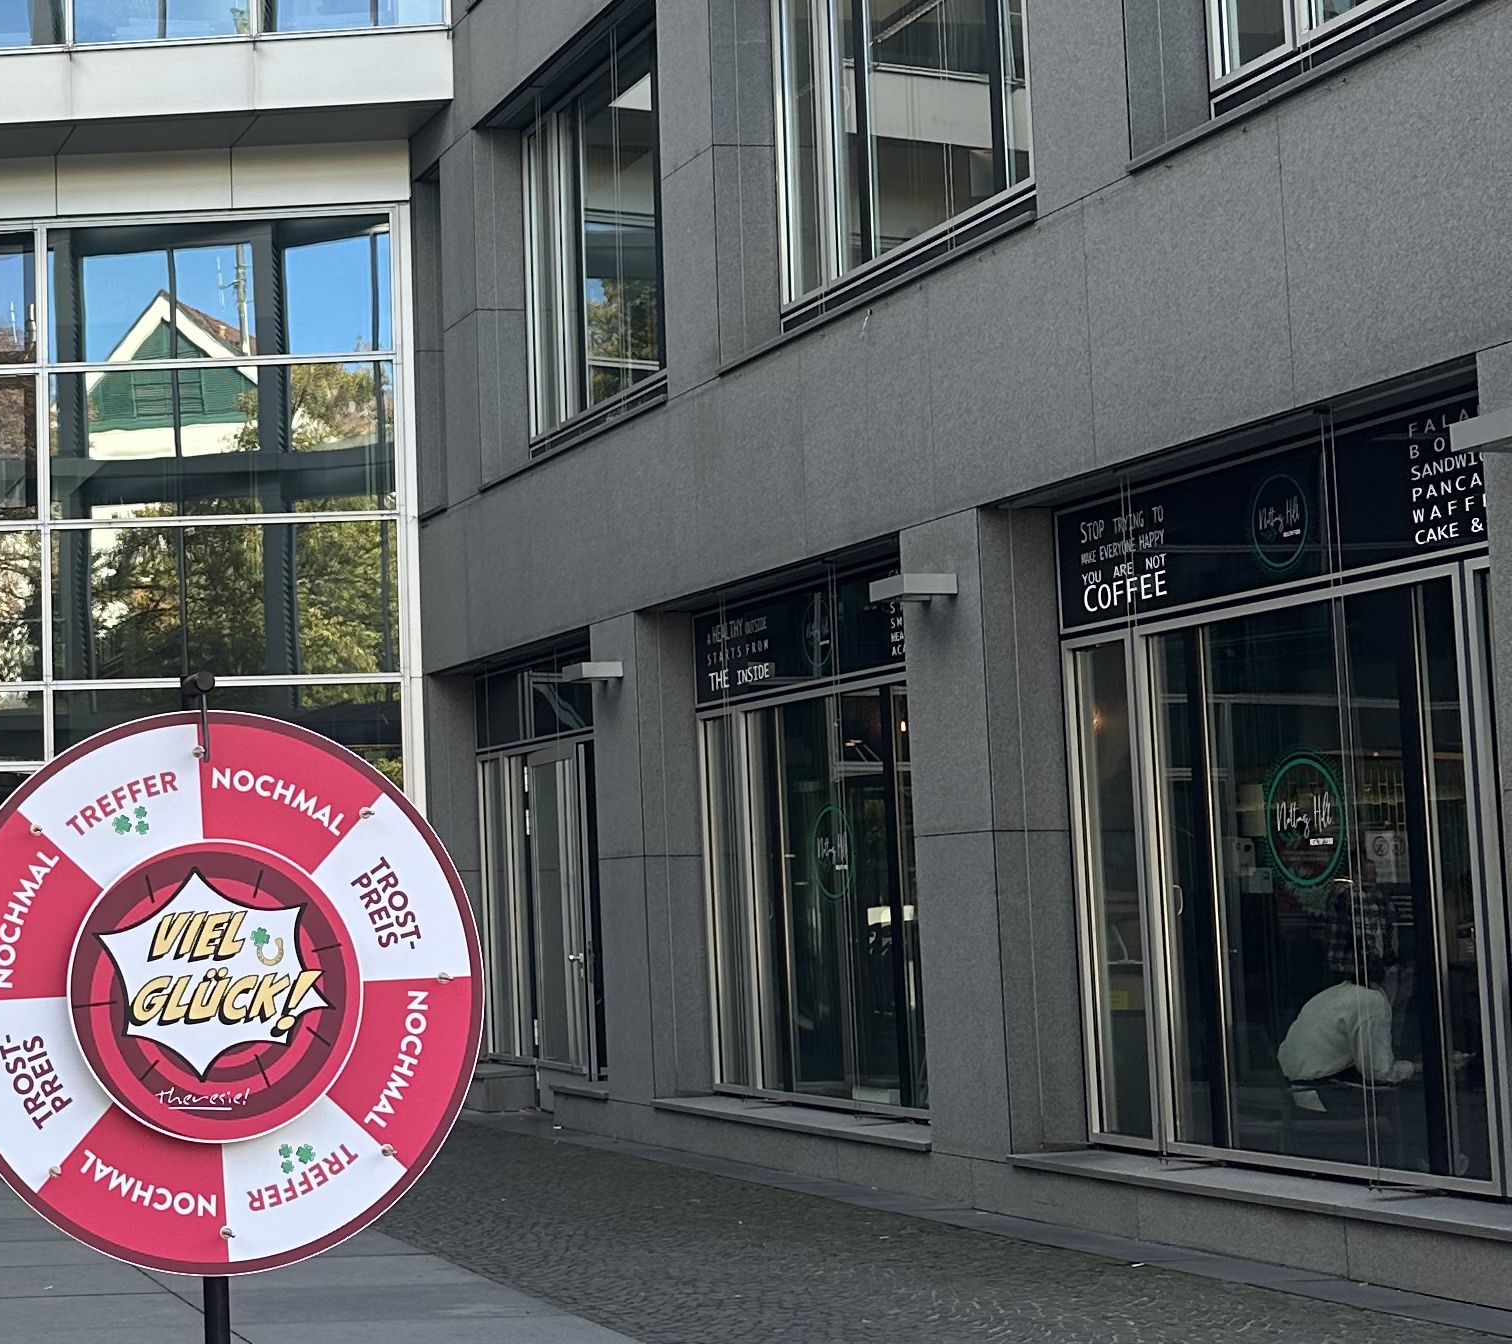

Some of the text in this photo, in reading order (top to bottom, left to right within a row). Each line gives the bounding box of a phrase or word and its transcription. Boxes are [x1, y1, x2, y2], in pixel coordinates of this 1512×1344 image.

[1151, 505, 1164, 523] TO
[1415, 517, 1484, 545] CAKE &
[1082, 553, 1166, 585] YOU ARE NOT
[1084, 570, 1168, 612] COFFEE
[708, 662, 770, 691] THE INSIDE
[65, 771, 179, 837] TREFFER
[211, 767, 348, 837] NOCHMAL
[147, 910, 247, 963] VIEL
[349, 874, 399, 950] PREIS
[373, 856, 423, 951] TROST-
[129, 967, 325, 1037] GLÜCK!
[4, 1034, 48, 1130] TROST-
[34, 1035, 74, 1115] PREIS
[364, 990, 429, 1128] NOCHMAL
[81, 1148, 218, 1217] NOCHMAL
[246, 1149, 359, 1212] TREFFER
